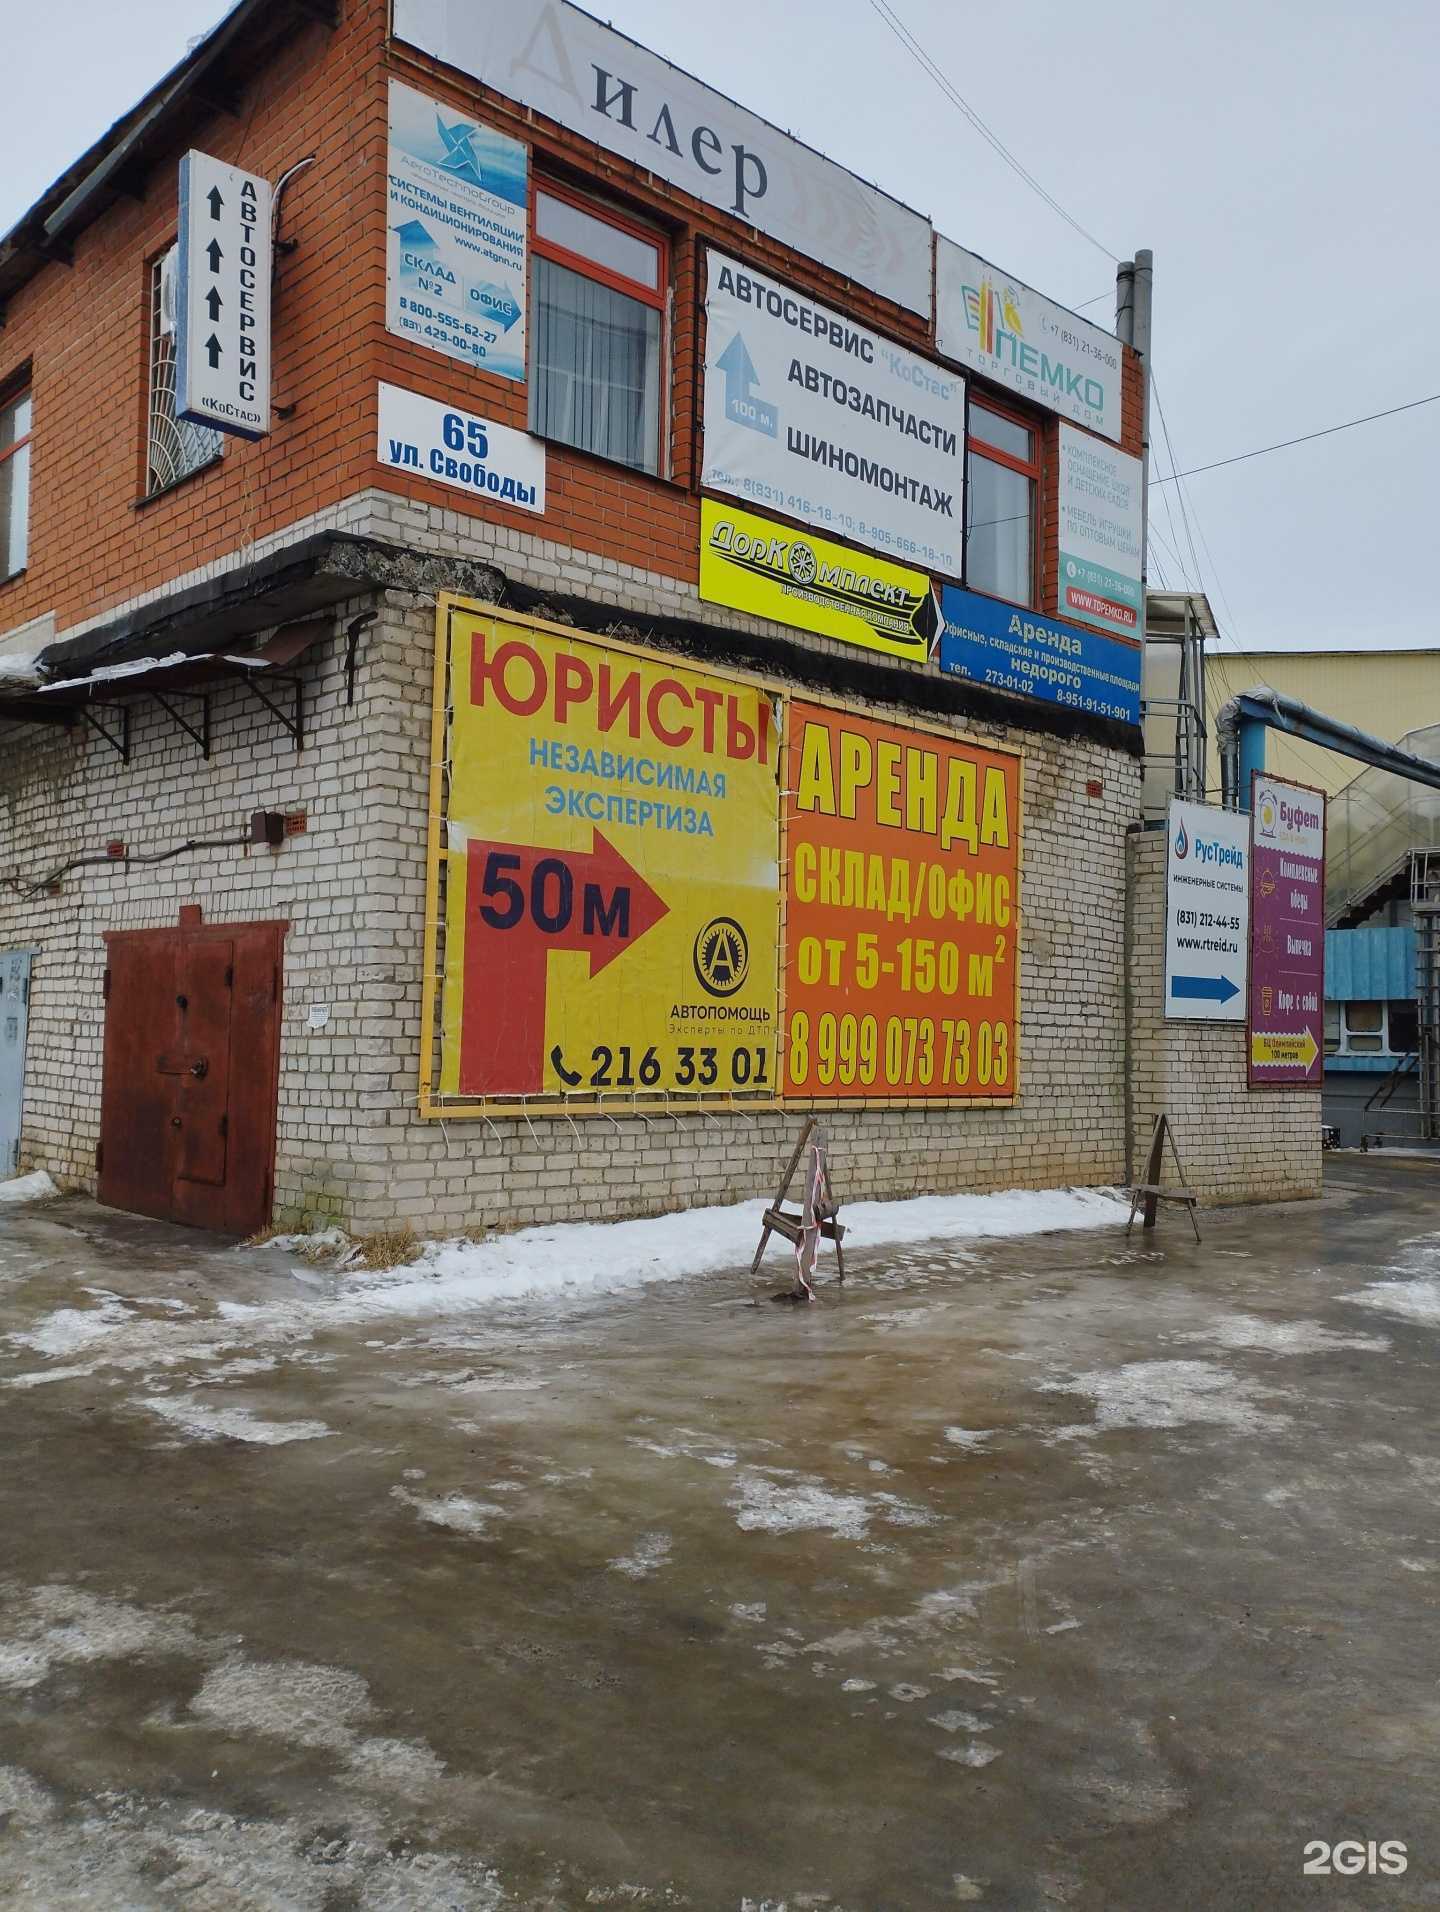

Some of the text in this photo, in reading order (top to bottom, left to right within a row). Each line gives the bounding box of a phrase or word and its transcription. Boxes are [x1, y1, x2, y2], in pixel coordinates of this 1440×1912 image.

[390, 175, 447, 210] СИСТЕМЫ
[449, 205, 524, 242] ВЕНТИЛЯЦИИ
[390, 190, 398, 201] И
[400, 192, 524, 257] КОНДИЦИОНИРОВАНИЯ
[405, 252, 456, 284] СКЛАД
[455, 235, 522, 272] www.atgnn.ru
[240, 180, 257, 402] АВТОСЕРВИС
[418, 277, 443, 297] №2
[470, 288, 512, 316] ОФИС
[399, 297, 497, 344] 8 800-555-62-27
[718, 265, 873, 364] АВТОСЕРВИС
[399, 316, 486, 358] (831) 429-00-80
[1050, 325, 1059, 337] +7
[1061, 329, 1079, 352] (831)
[731, 399, 773, 427] 100 м.
[788, 359, 956, 456] АВТОЗАПЧАСТИ
[443, 413, 488, 459] 65
[390, 439, 535, 505] ул. Свободы
[744, 478, 784, 505] 8(831)
[787, 427, 953, 517] ШИНОМОНТАЖ
[1071, 592, 1133, 624] WWW.TOPEMKO.RU
[1008, 614, 1082, 656] Аренда
[989, 637, 1033, 659] складские
[1034, 649, 1040, 659] и
[1041, 652, 1110, 683] производственные
[1110, 673, 1140, 694] площади
[1011, 658, 1082, 689] недорого
[469, 631, 770, 765] ЮРИСТЫ
[950, 662, 1130, 721] тел. 273-01-02 8-951-91-51-901
[529, 737, 727, 799] НЕЗАВИСИМАЯ
[796, 721, 1009, 855] АРЕНДА
[544, 785, 714, 837] ЭКСПЕРТИЗА
[1280, 801, 1319, 832] Буфет
[1195, 838, 1243, 870] РусТрейд
[794, 842, 1010, 928] СКЛАД/ОФИС
[1173, 874, 1243, 893] ИНЖЕНЕРНЫЕ СИСТЕМЫ
[1176, 908, 1240, 930] (831) 212-44-55
[855, 932, 959, 996] 5-150
[1176, 936, 1238, 954] www.rtreid.ru
[670, 1004, 770, 1023] АВТОПОМОЩЬ
[1278, 990, 1293, 1018] Кофе
[669, 1023, 770, 1036] Эксперты по ДТП
[789, 1010, 1008, 1087] 8 999 073 73 03
[590, 1046, 767, 1087] 216 33 01
[1271, 1049, 1281, 1060] 100
